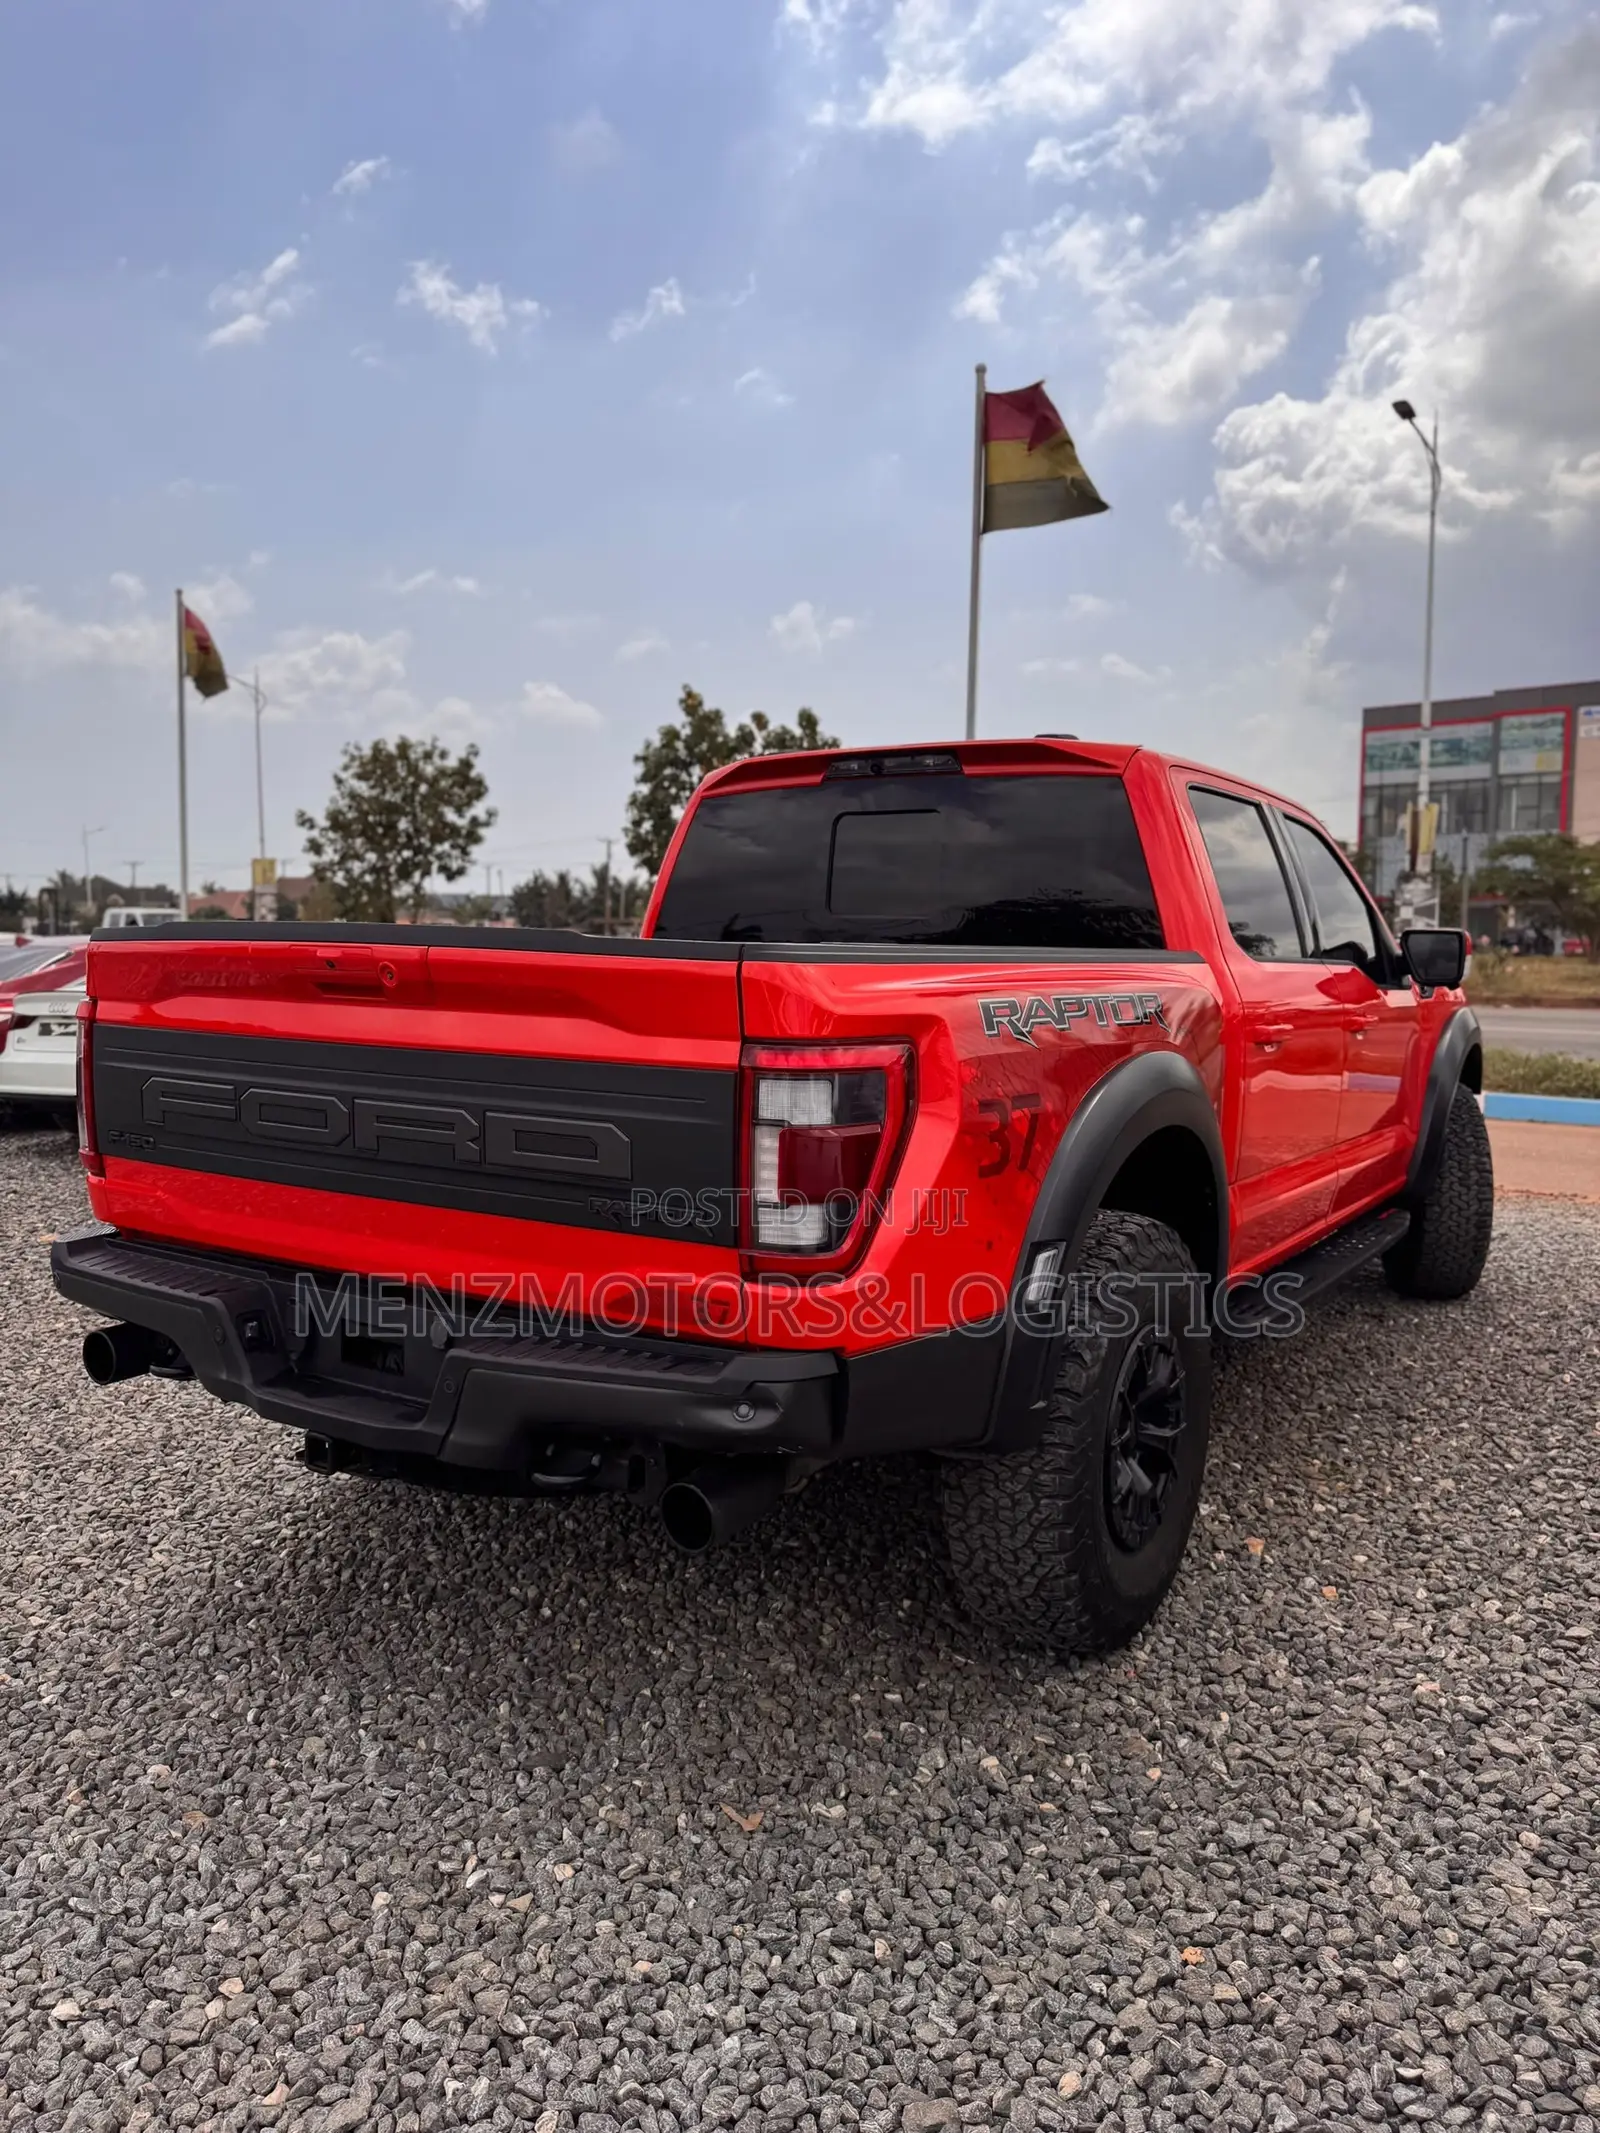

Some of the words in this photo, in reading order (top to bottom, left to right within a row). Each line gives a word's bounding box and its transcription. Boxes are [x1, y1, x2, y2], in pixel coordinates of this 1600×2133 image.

[978, 993, 1172, 1049] RAPTOR
[141, 1076, 633, 1181] FORD
[978, 1093, 1042, 1178] 37
